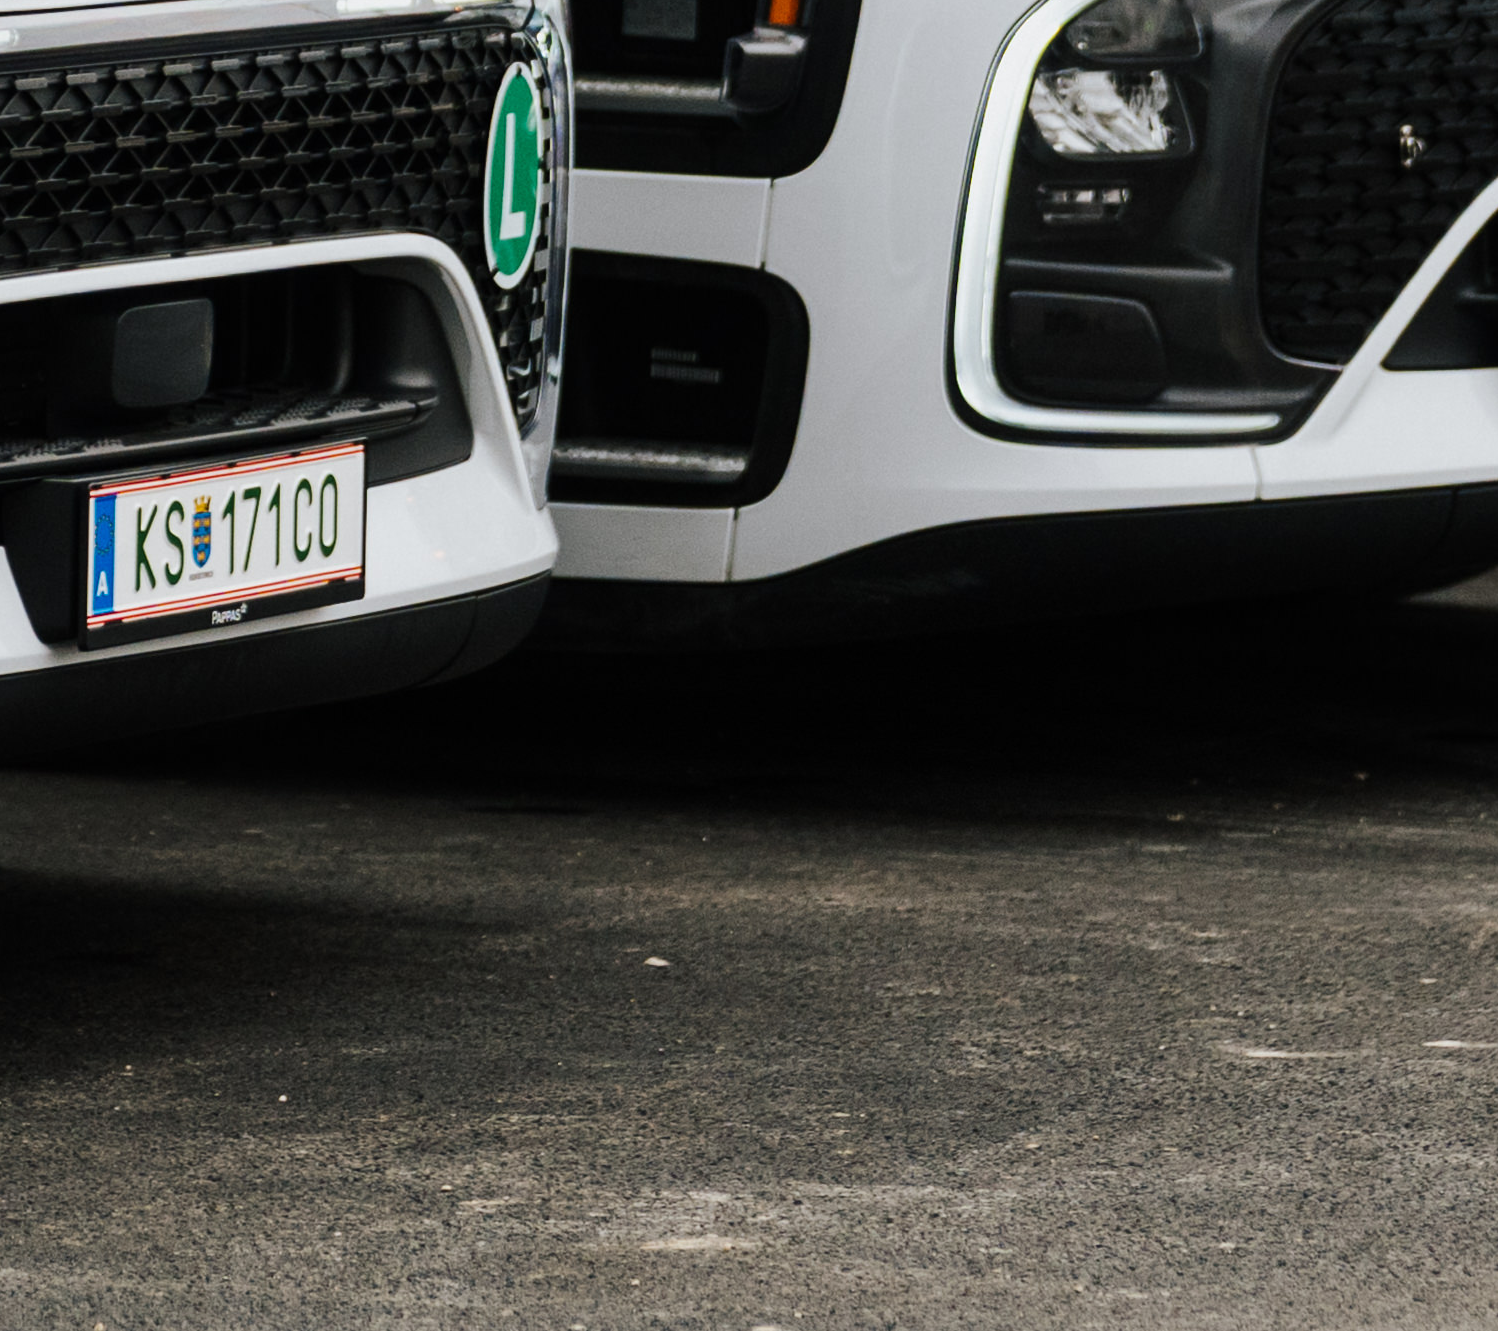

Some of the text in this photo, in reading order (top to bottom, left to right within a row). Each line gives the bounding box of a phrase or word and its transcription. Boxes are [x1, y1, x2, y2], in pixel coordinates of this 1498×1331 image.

[500, 112, 525, 239] L
[96, 570, 108, 597] A
[135, 500, 185, 593] KS
